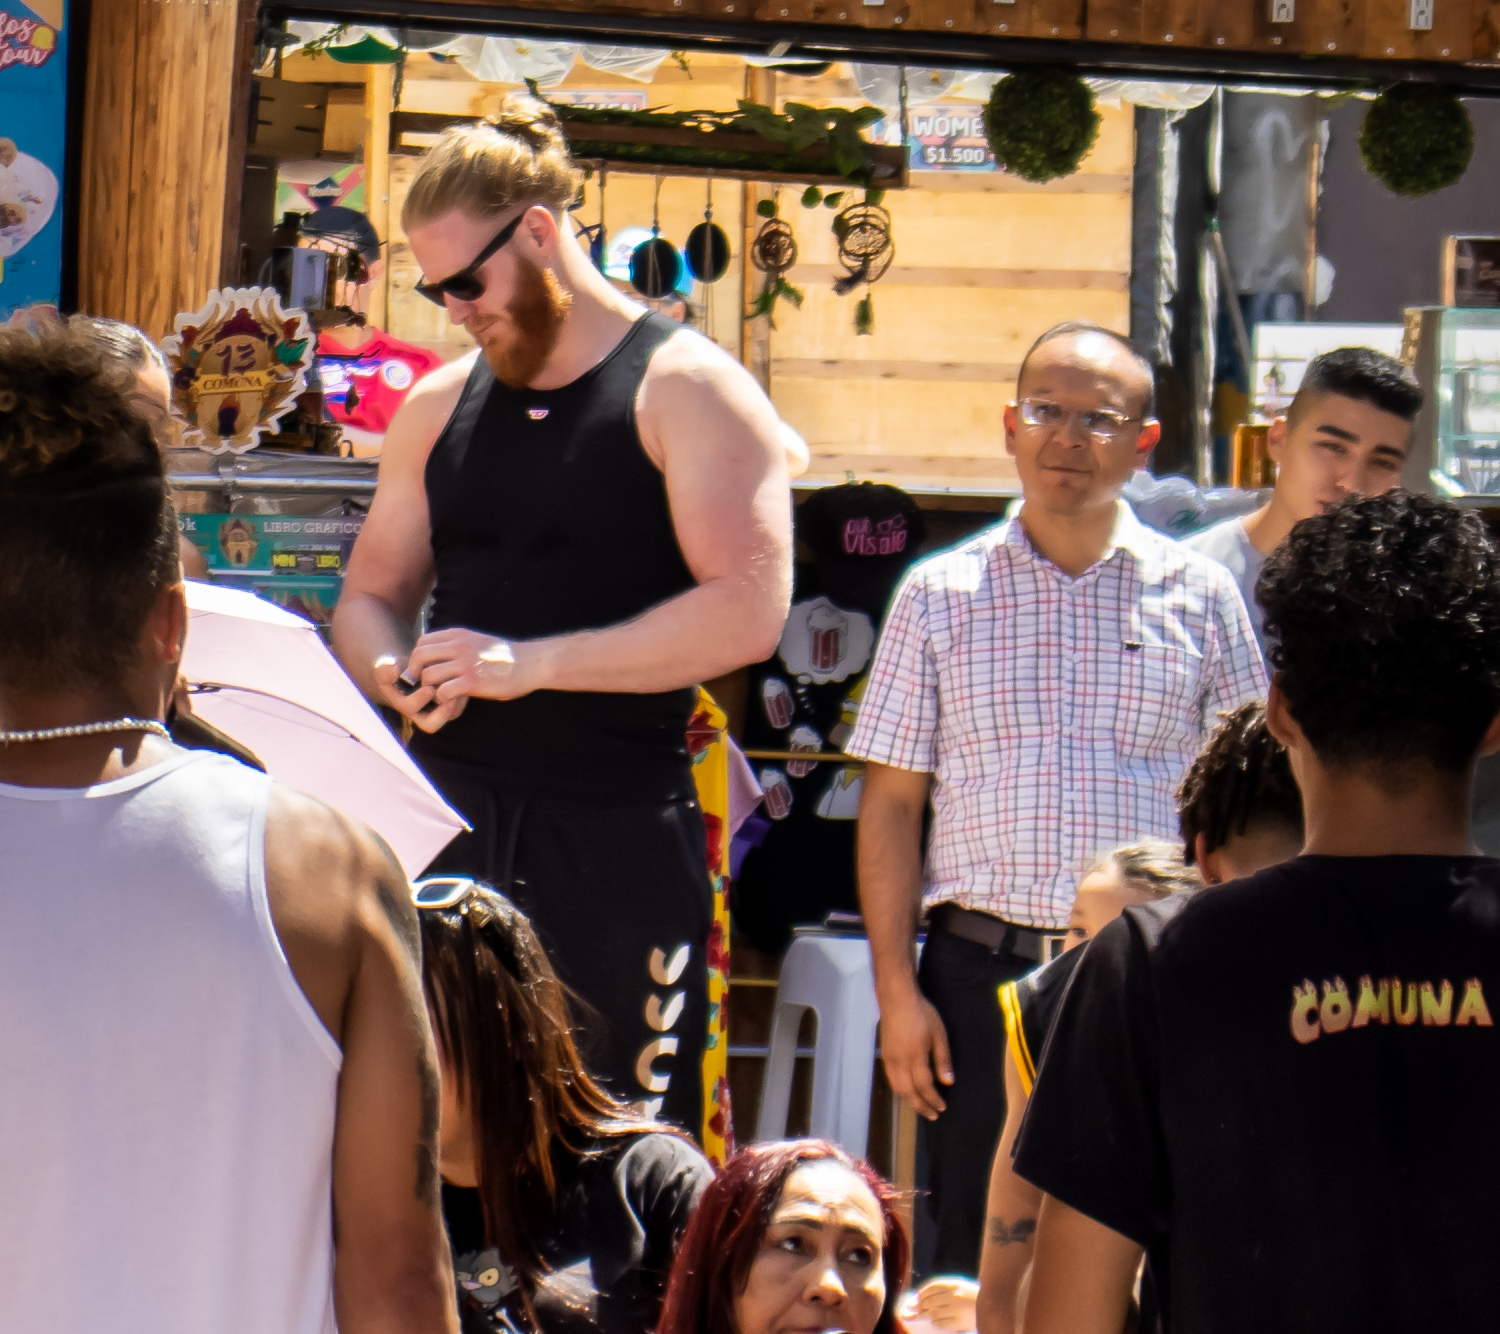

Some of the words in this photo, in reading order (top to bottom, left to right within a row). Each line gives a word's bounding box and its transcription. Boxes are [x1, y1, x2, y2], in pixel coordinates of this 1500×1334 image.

[911, 115, 984, 138] WOME
[926, 146, 986, 164] $1.500
[215, 342, 257, 375] 13
[202, 376, 264, 391] COMUNA
[263, 522, 301, 533] LIBRO
[1290, 974, 1494, 1045] COMUNA
